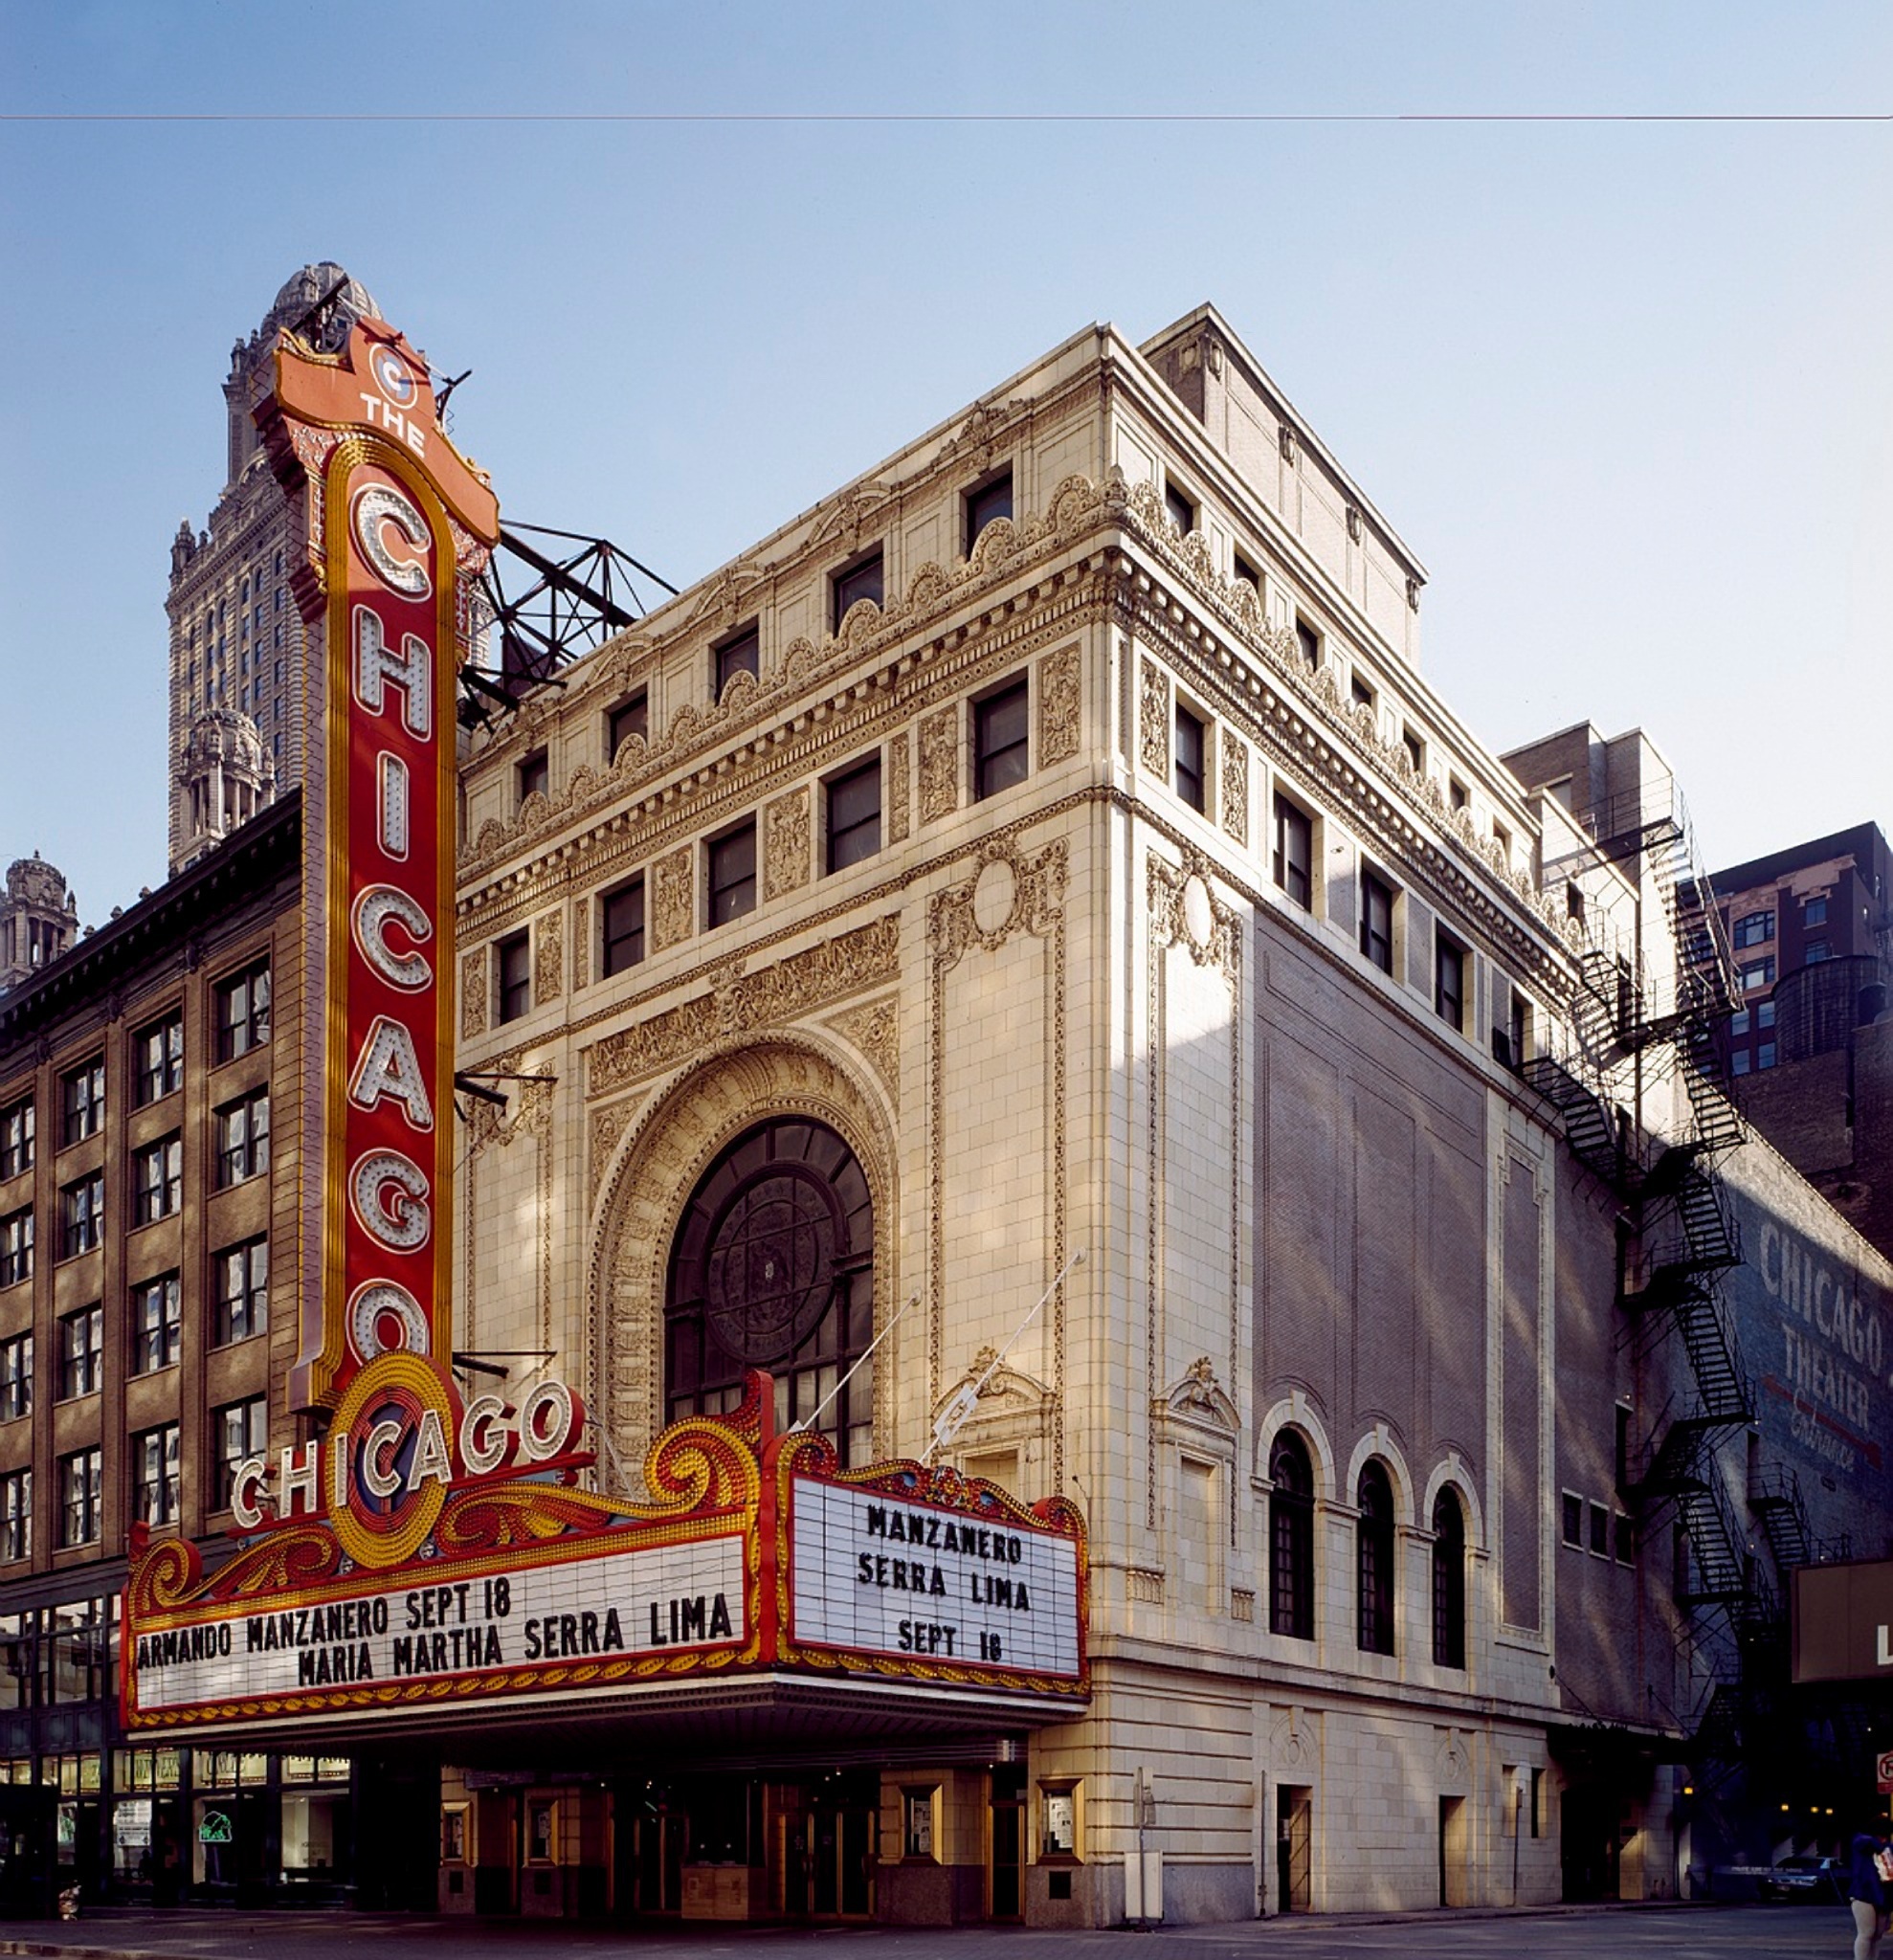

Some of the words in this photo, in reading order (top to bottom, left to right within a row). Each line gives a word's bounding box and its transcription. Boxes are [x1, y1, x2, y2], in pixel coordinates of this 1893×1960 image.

[360, 392, 425, 458] THE
[346, 482, 433, 1369] CHICAGO
[1760, 1221, 1883, 1376] CHICAGO
[1781, 1322, 1868, 1432] THEATER
[230, 1380, 574, 1529] CHICAGO
[867, 1503, 1022, 1565] MANZANERO
[137, 1620, 231, 1670] ARMANDO
[246, 1596, 389, 1654] MANZANERO
[406, 1583, 470, 1630] SEPT
[484, 1576, 511, 1618] 18
[857, 1551, 946, 1596] SERRA
[970, 1571, 1030, 1612] LIMA
[298, 1643, 372, 1687] MARIA
[393, 1623, 502, 1676] MARTHA
[524, 1607, 624, 1659] SERRA
[651, 1592, 733, 1646] LIMA
[898, 1618, 957, 1657] SEPT
[979, 1630, 1002, 1662] 18
